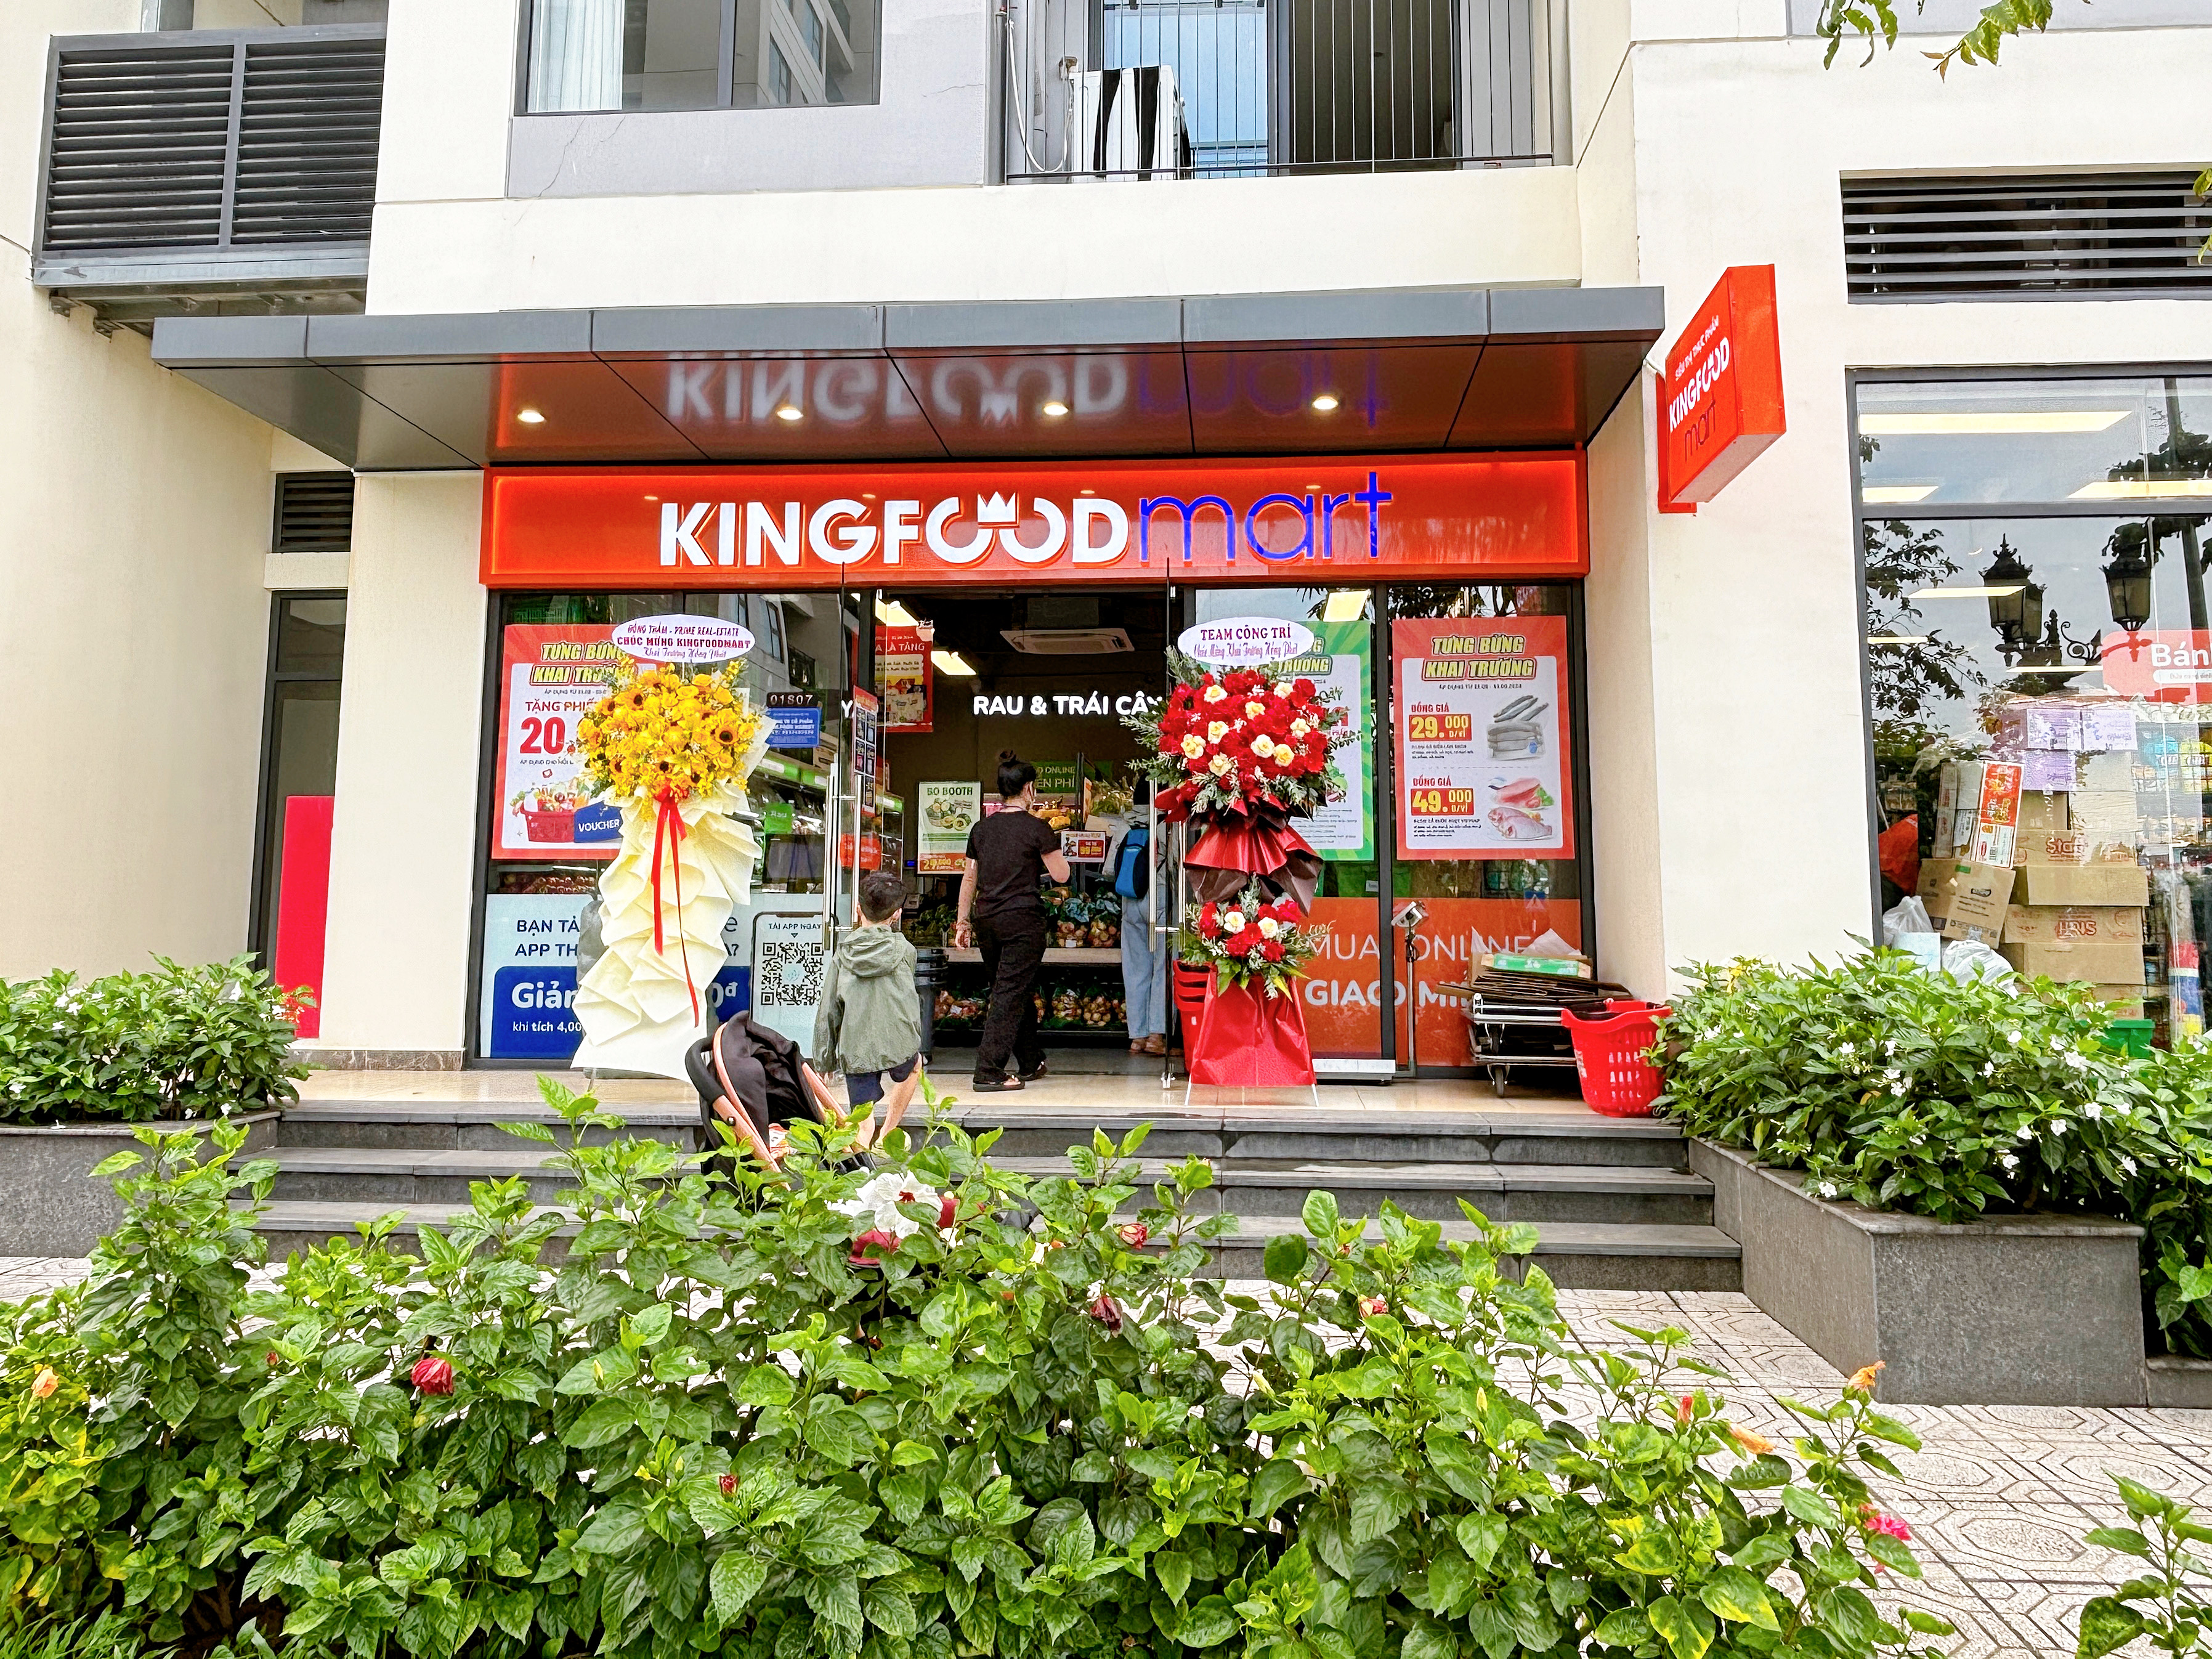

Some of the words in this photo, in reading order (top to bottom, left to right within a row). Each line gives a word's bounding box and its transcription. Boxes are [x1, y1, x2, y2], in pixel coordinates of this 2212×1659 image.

[1669, 336, 1730, 433] KINGFOOD
[1684, 391, 1716, 463] mart
[617, 635, 643, 646] CHÚC
[676, 639, 751, 649] KINGFOODMART
[1201, 628, 1233, 641] TEAM
[1236, 625, 1268, 639] CÔNG
[2150, 641, 2212, 667] Bán
[532, 665, 572, 683] KHAI
[1425, 660, 1465, 678] KHAI
[525, 698, 561, 714] TẶNG
[564, 697, 598, 712] PHIẾ
[973, 695, 1023, 715] RAU
[1030, 695, 1048, 715] &
[1052, 690, 1109, 715] TRÁI
[519, 716, 565, 755] 20
[578, 818, 620, 832] VOUCHER
[516, 919, 553, 936] BẠN
[558, 915, 580, 933] TẢ
[514, 943, 550, 957] APP
[554, 943, 578, 957] TH
[1308, 933, 1380, 961] MUA
[1413, 933, 1532, 962] ONLNE
[1305, 979, 1407, 1007] GIAO
[512, 1021, 529, 1032] khi
[531, 1020, 554, 1032] tích
[556, 1021, 582, 1033] 4,00
